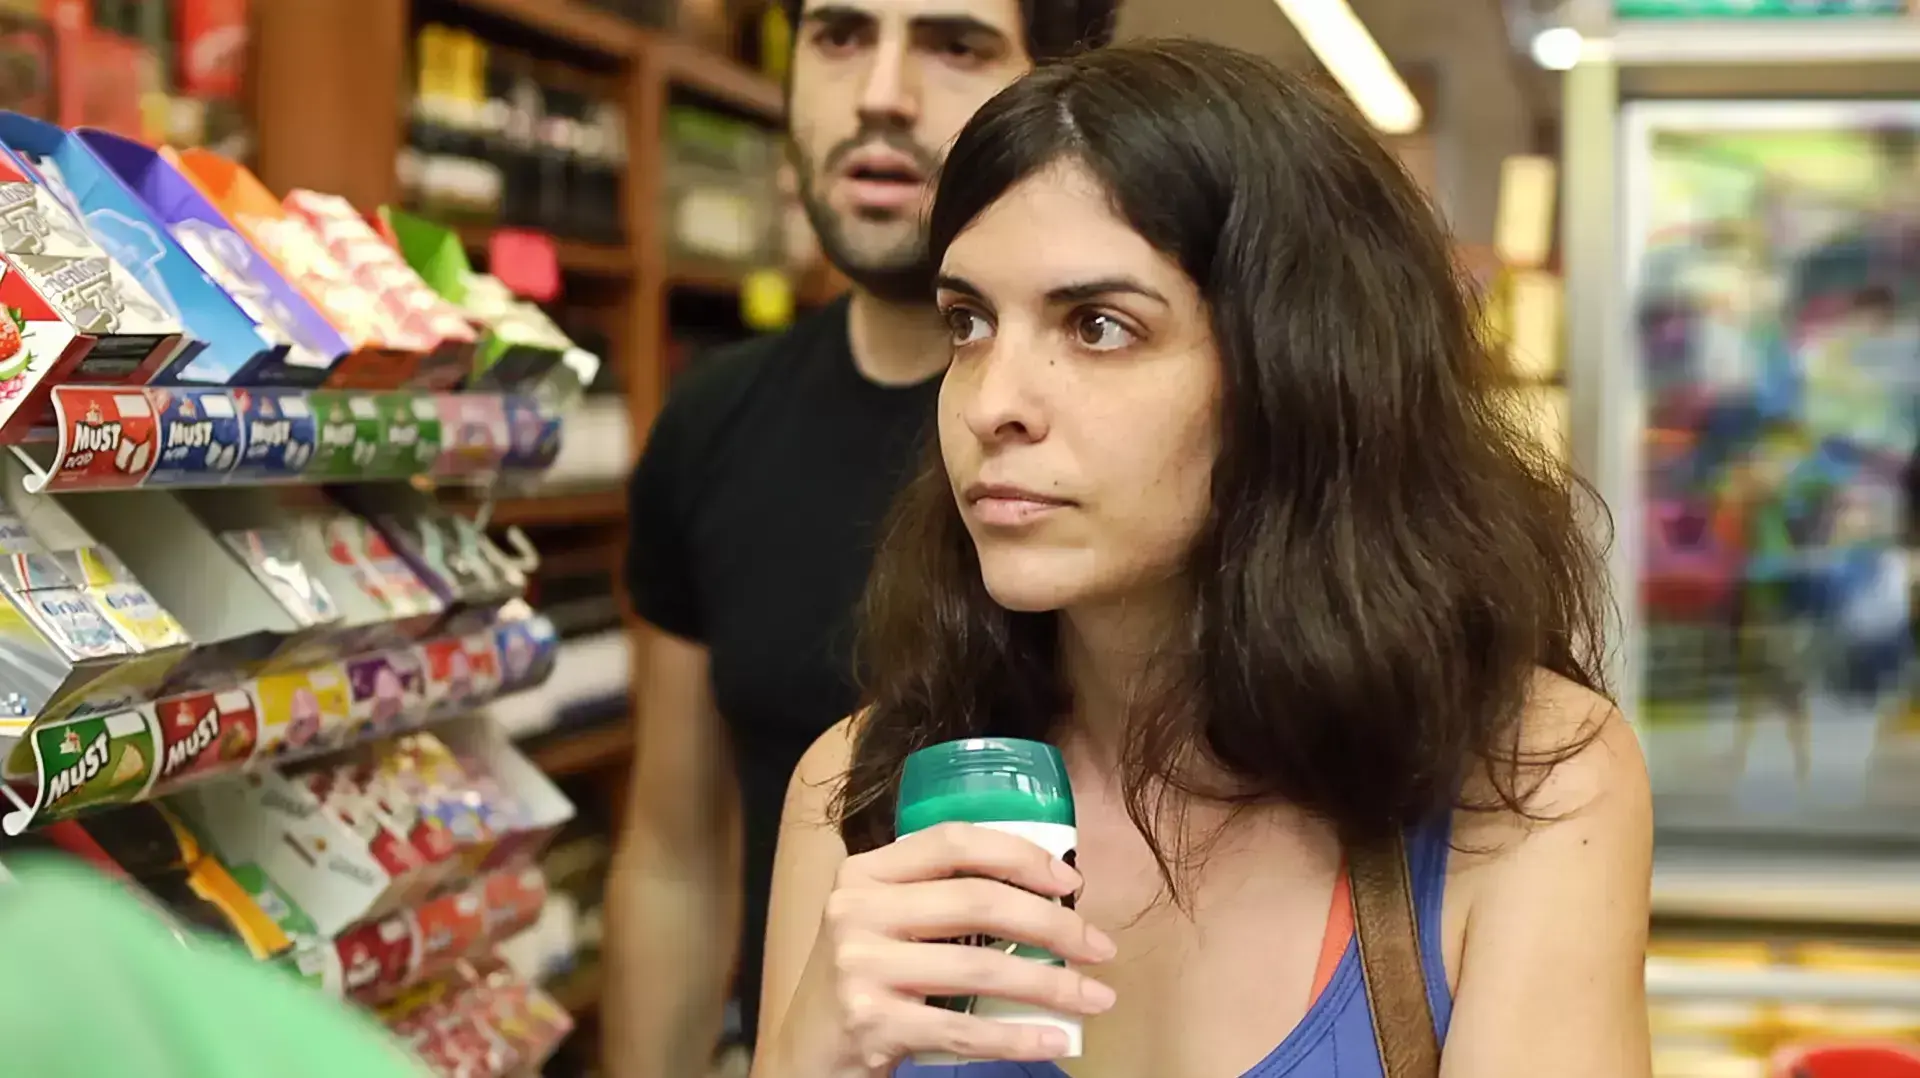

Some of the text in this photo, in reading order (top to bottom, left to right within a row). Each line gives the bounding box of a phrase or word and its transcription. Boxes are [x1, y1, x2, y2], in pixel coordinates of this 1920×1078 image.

[72, 421, 122, 454] MUST
[167, 420, 213, 447] MUST
[163, 708, 218, 776] MUST
[43, 732, 109, 809] MUST
